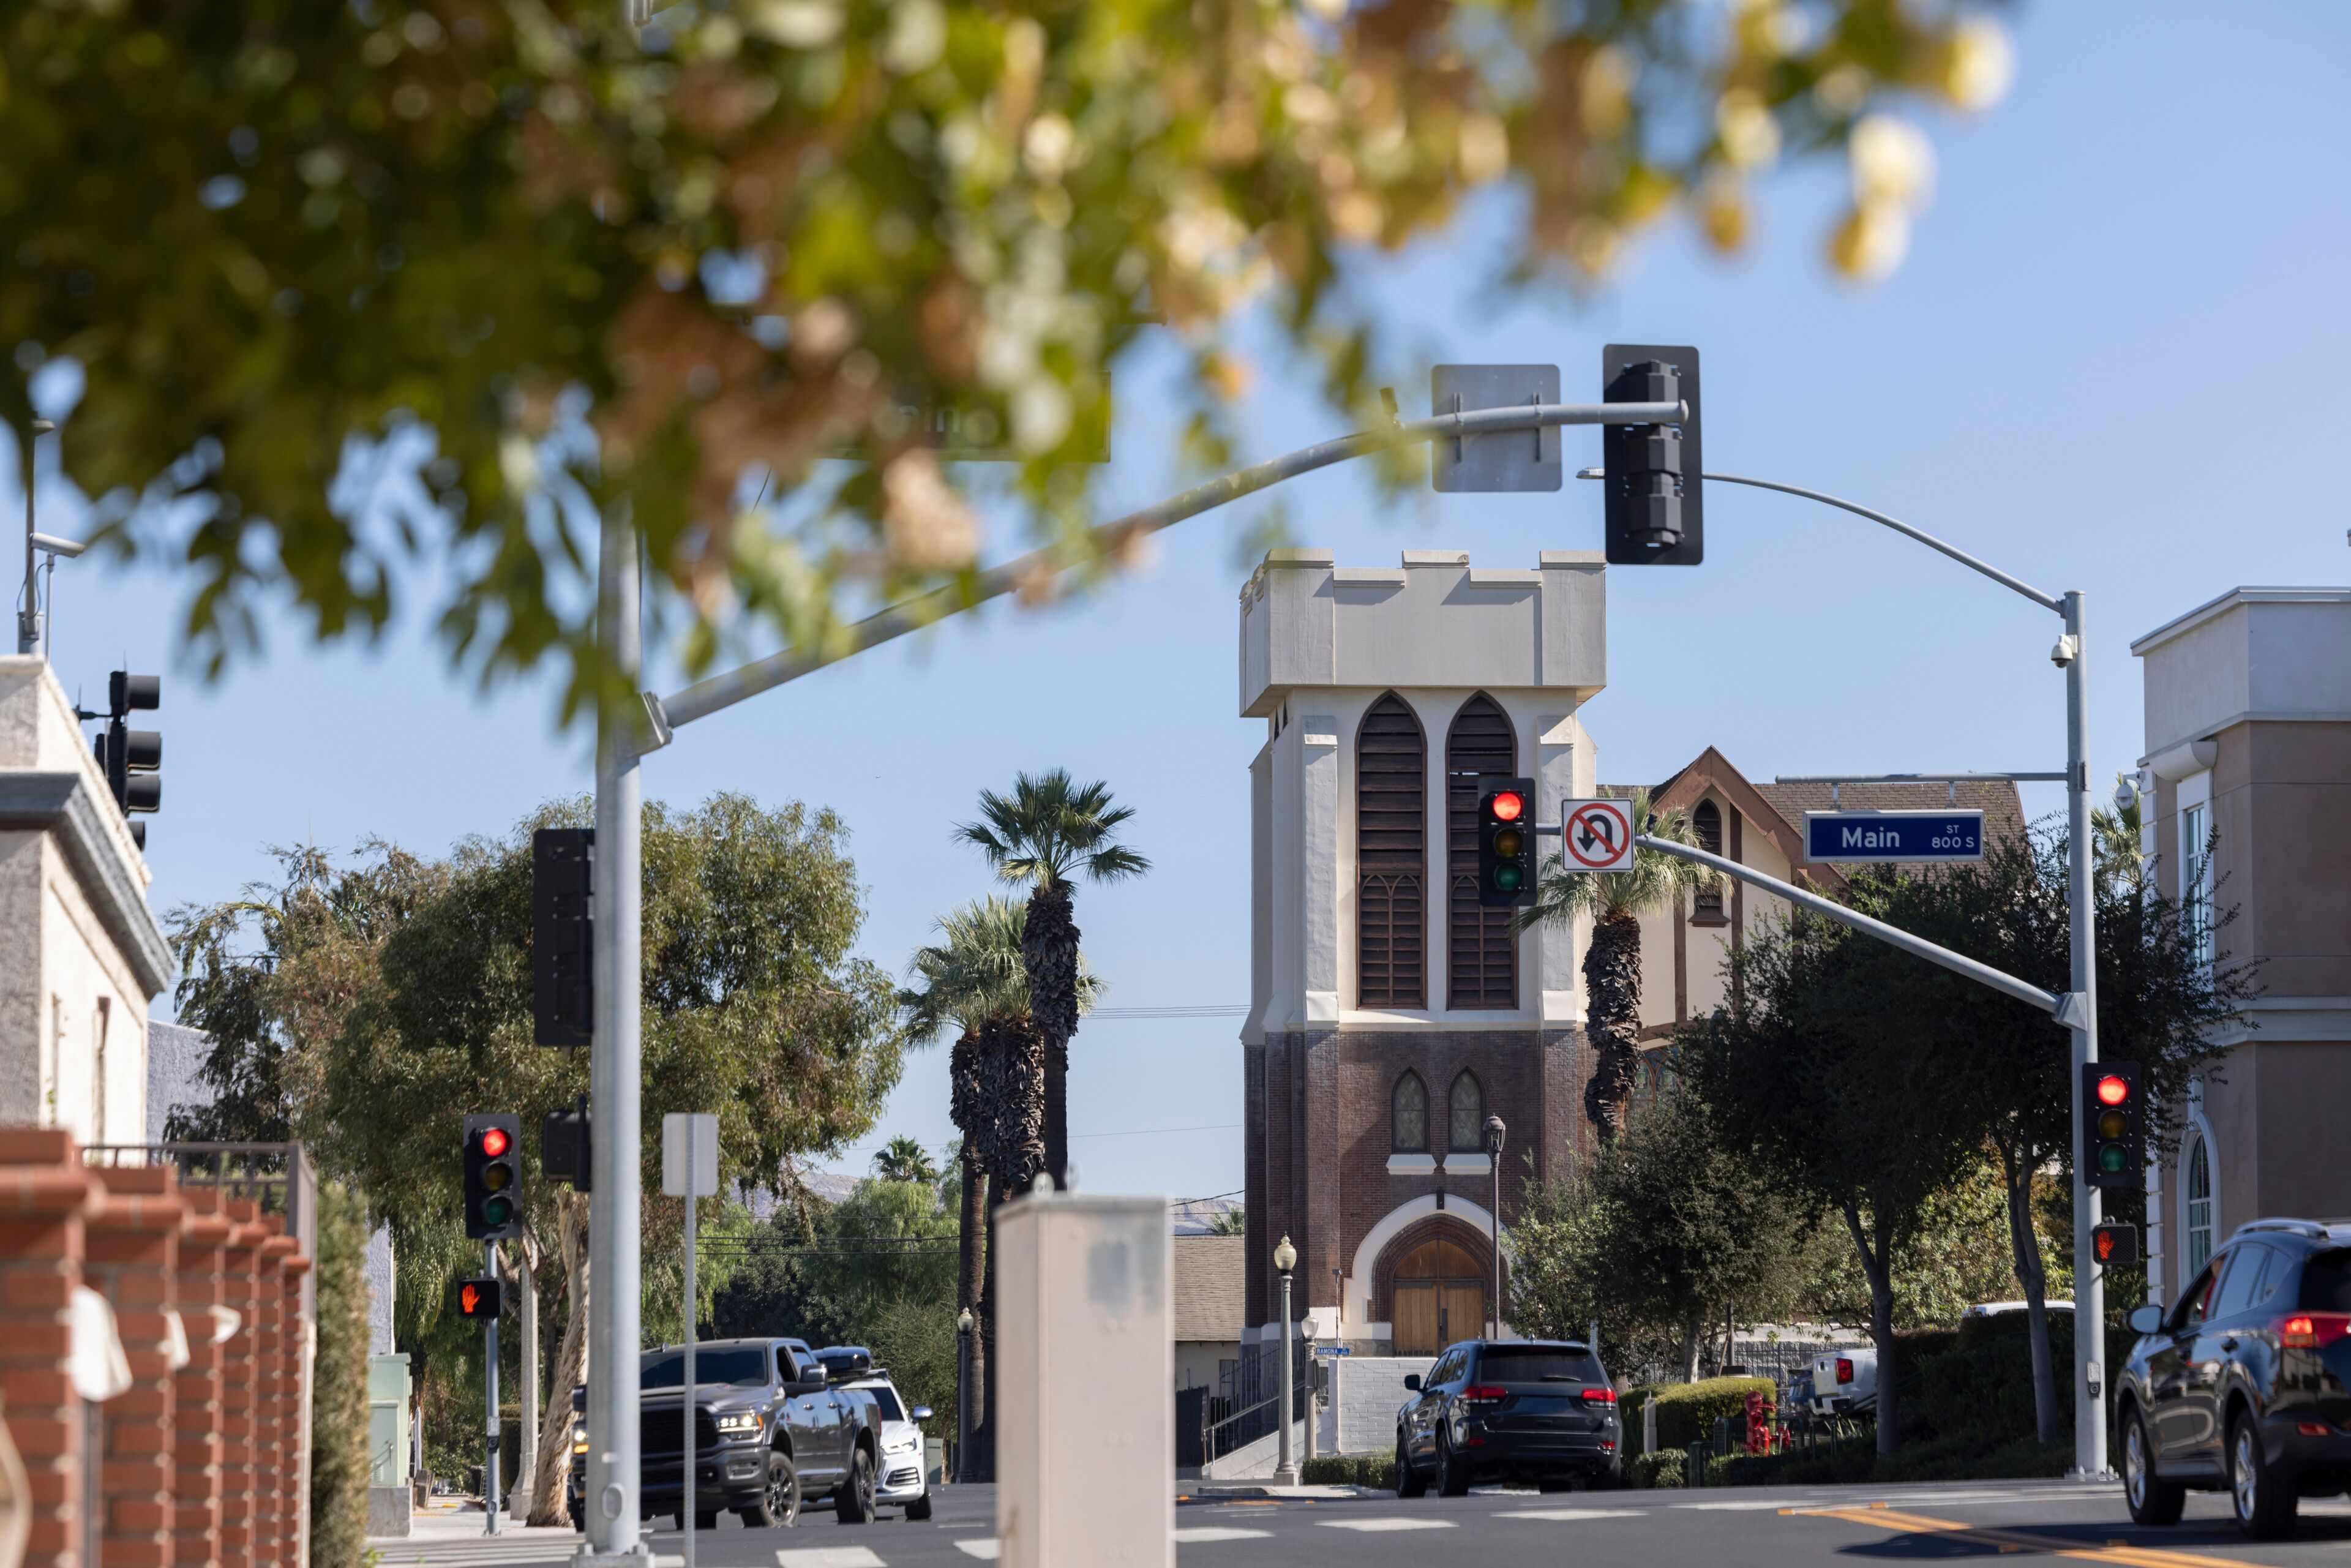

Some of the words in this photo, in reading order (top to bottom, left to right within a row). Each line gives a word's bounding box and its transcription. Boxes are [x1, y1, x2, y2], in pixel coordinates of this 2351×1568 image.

[1946, 825, 1960, 834] ST
[1842, 827, 1900, 848] Main
[1932, 836, 1962, 848] 800
[1965, 836, 1974, 848] S
